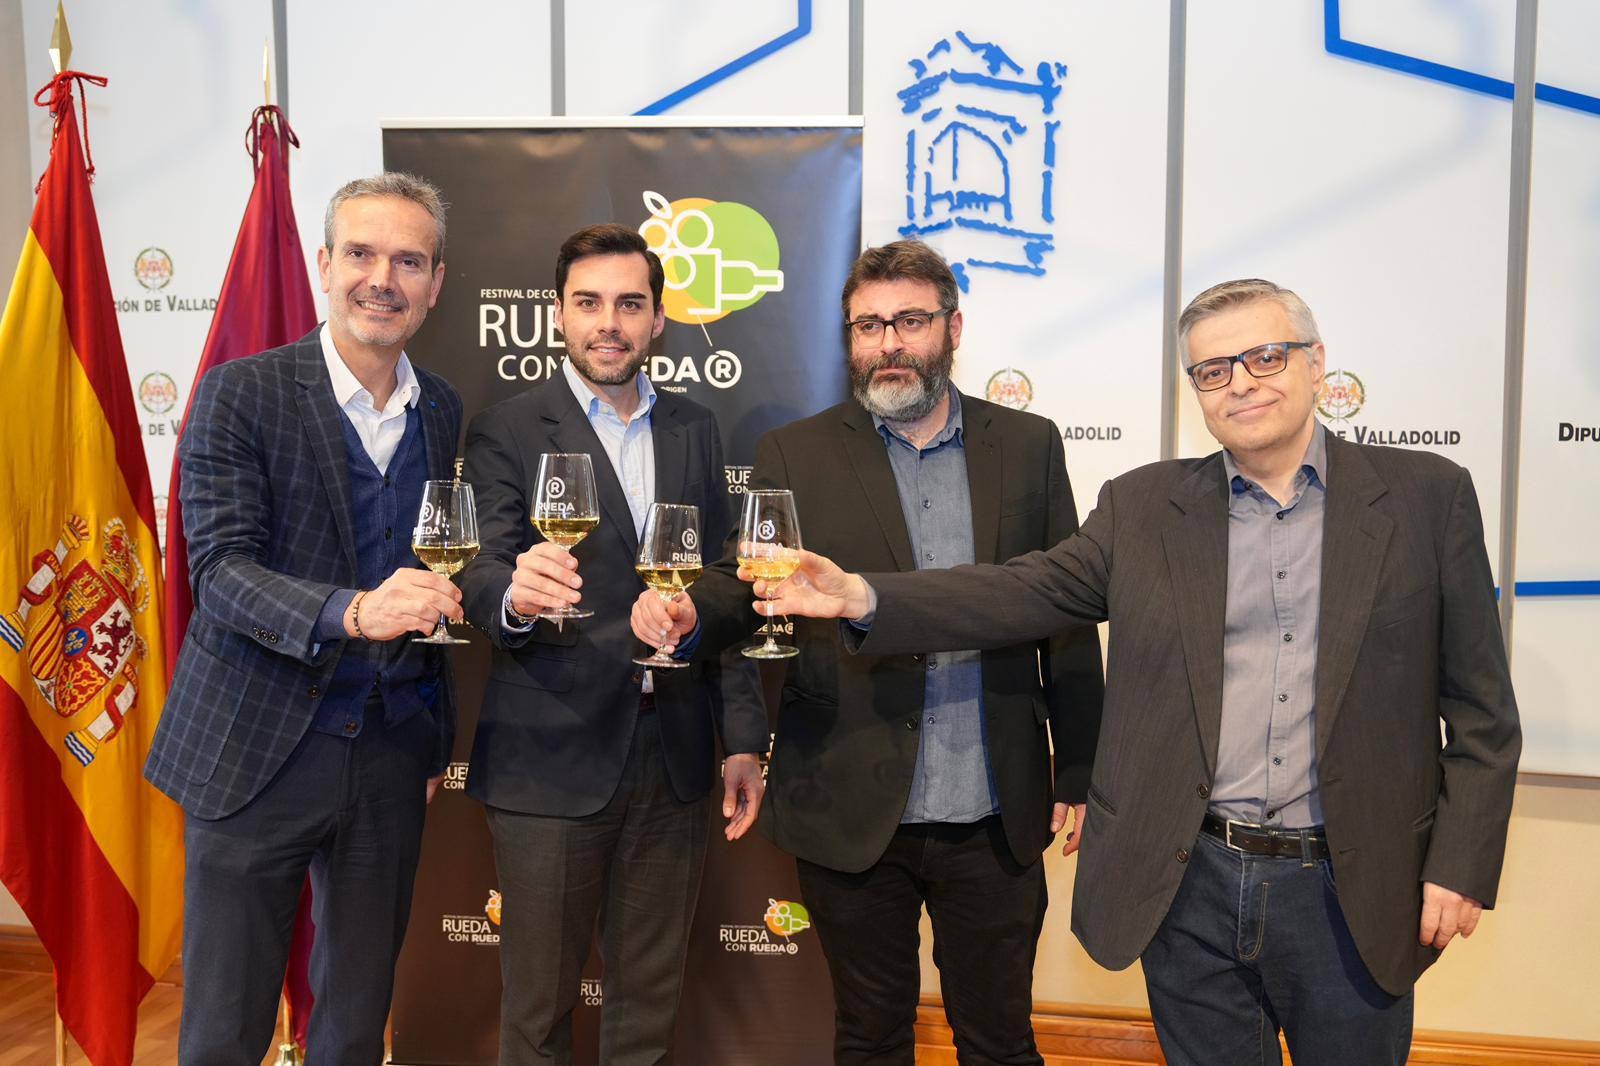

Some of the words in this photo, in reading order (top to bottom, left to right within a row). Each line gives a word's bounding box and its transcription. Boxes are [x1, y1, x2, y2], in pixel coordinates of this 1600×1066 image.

[480, 289, 525, 299] FESTIVAL
[526, 289, 540, 299] DE
[144, 299, 162, 312] DE
[641, 355, 702, 382] DA
[1062, 426, 1122, 440] ADOLID
[1354, 426, 1461, 445] VALLADOLID
[442, 918, 491, 934] RUEDA
[448, 932, 470, 942] CON
[719, 928, 770, 943] RUEDA
[725, 942, 747, 952] CON
[580, 982, 603, 997] RU
